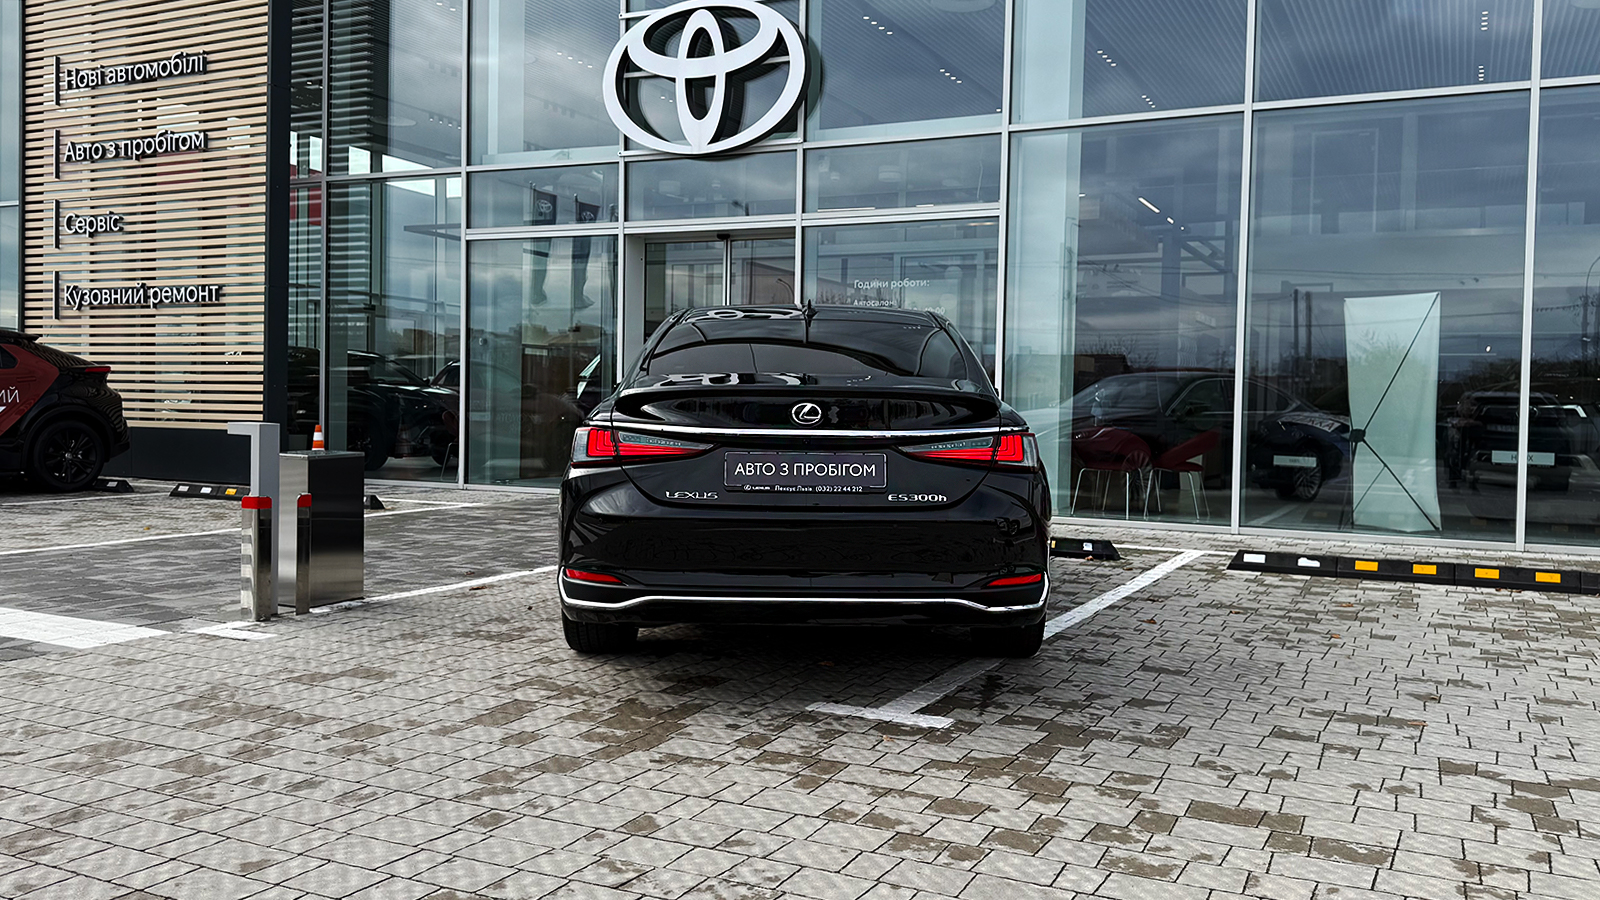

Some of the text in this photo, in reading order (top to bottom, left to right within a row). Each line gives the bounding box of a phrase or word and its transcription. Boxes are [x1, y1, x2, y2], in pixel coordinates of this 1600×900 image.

[65, 50, 206, 90] Нові автомобілі
[64, 129, 207, 162] Авто з пробігом
[64, 211, 121, 238] Сервіс
[853, 278, 930, 290] Години роботи:
[64, 282, 220, 310] Кузовний ремонт
[734, 463, 776, 476] АВТО
[793, 463, 876, 477] ПРОБІГОМ
[665, 491, 719, 499] LEXUS
[887, 493, 948, 502] ES300h
